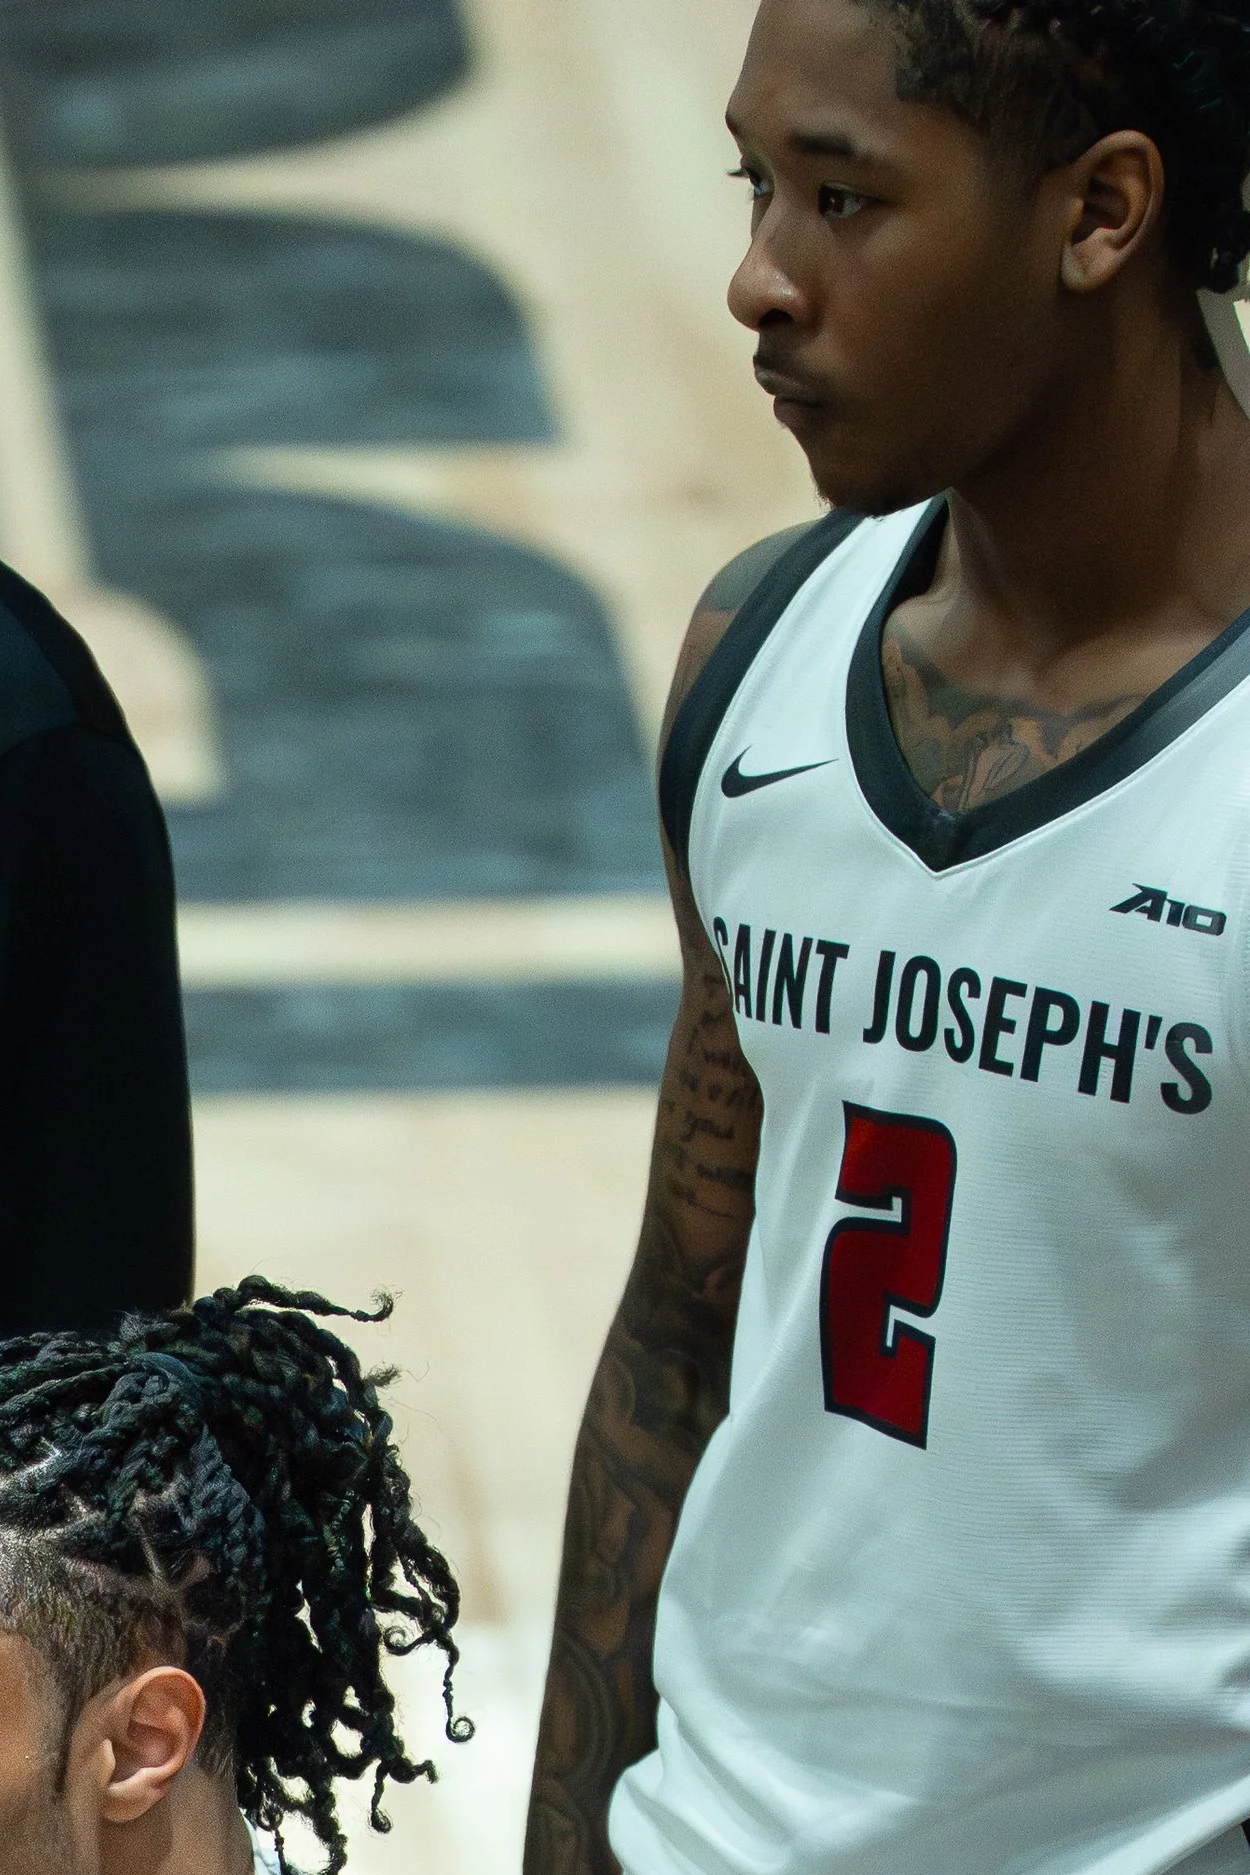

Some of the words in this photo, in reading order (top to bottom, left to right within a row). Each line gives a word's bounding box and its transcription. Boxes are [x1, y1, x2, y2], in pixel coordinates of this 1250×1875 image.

[1109, 882, 1227, 938] A10
[862, 949, 1214, 1115] JOSEPH'S
[820, 1099, 958, 1450] 2
